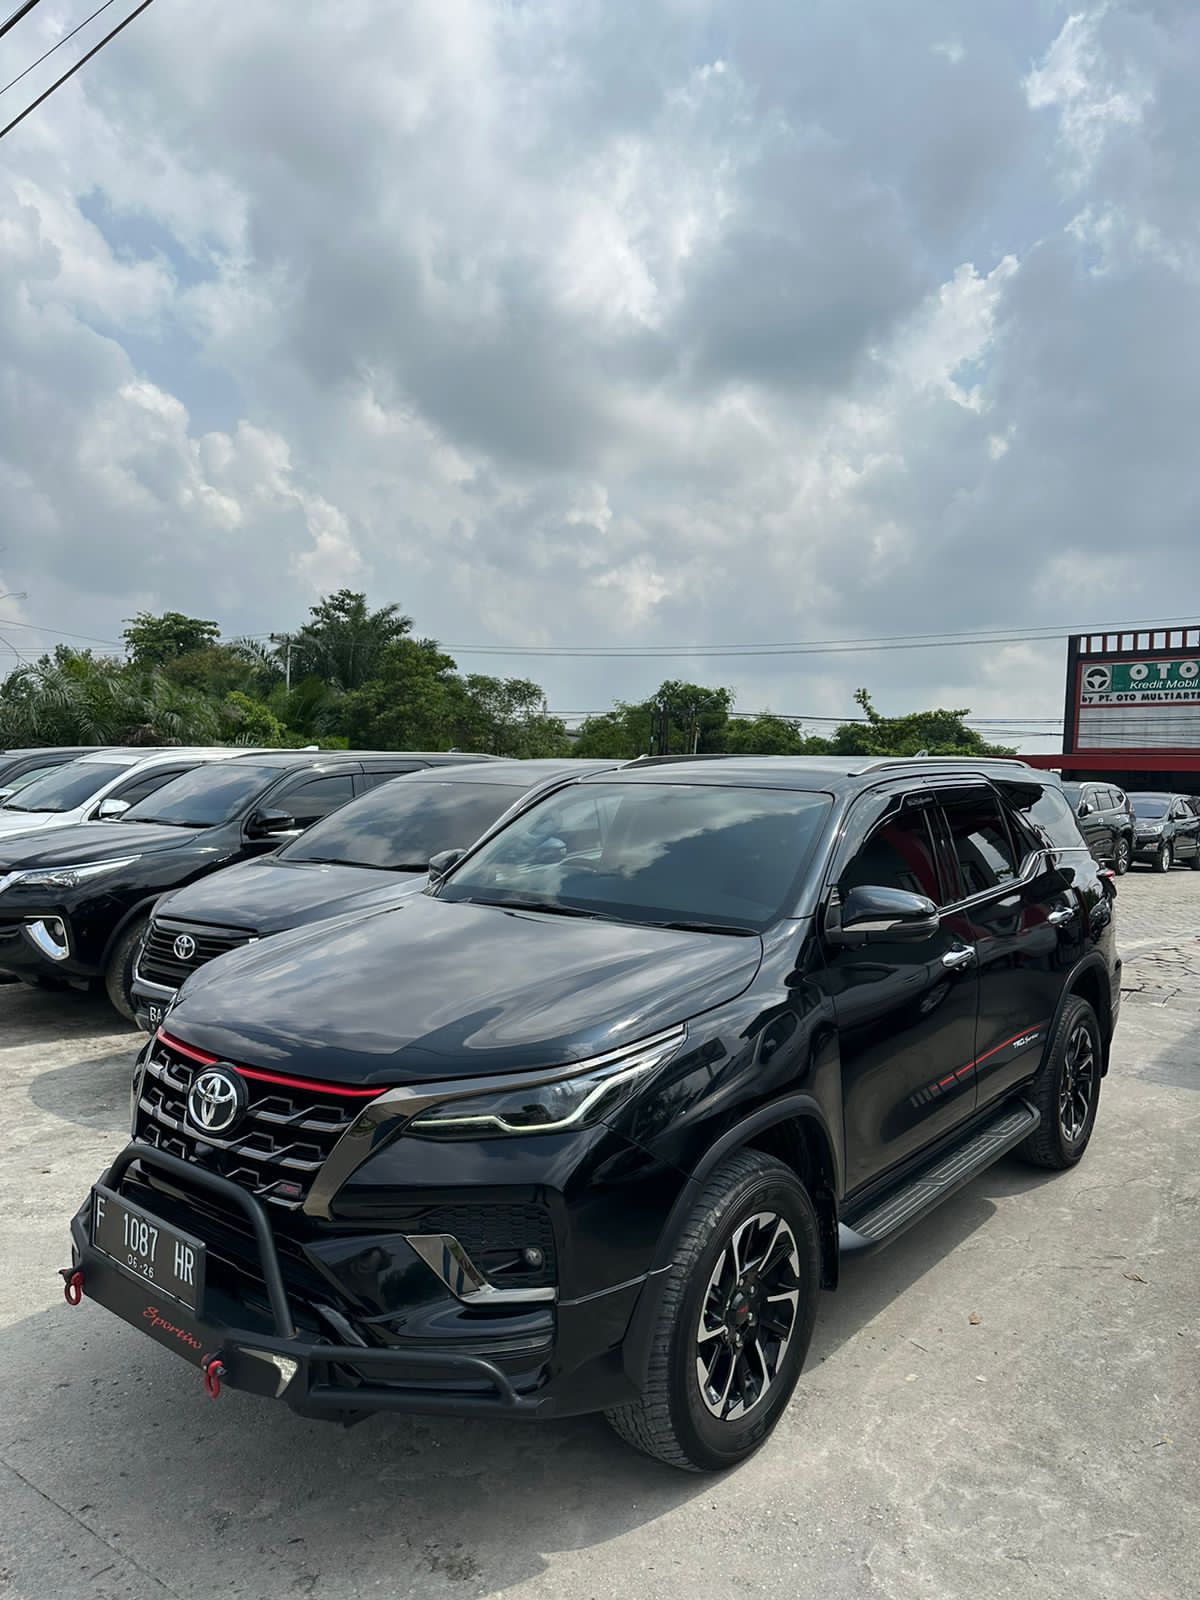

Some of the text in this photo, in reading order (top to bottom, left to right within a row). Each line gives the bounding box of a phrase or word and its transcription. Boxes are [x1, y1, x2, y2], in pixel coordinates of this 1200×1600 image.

[1129, 662, 1199, 680] OTO
[1130, 680, 1198, 689] Kredit Mobil
[1082, 695, 1093, 703] by
[1099, 694, 1112, 702] PT.
[1116, 693, 1136, 701] OTO
[97, 1196, 194, 1285] F 1087 HR
